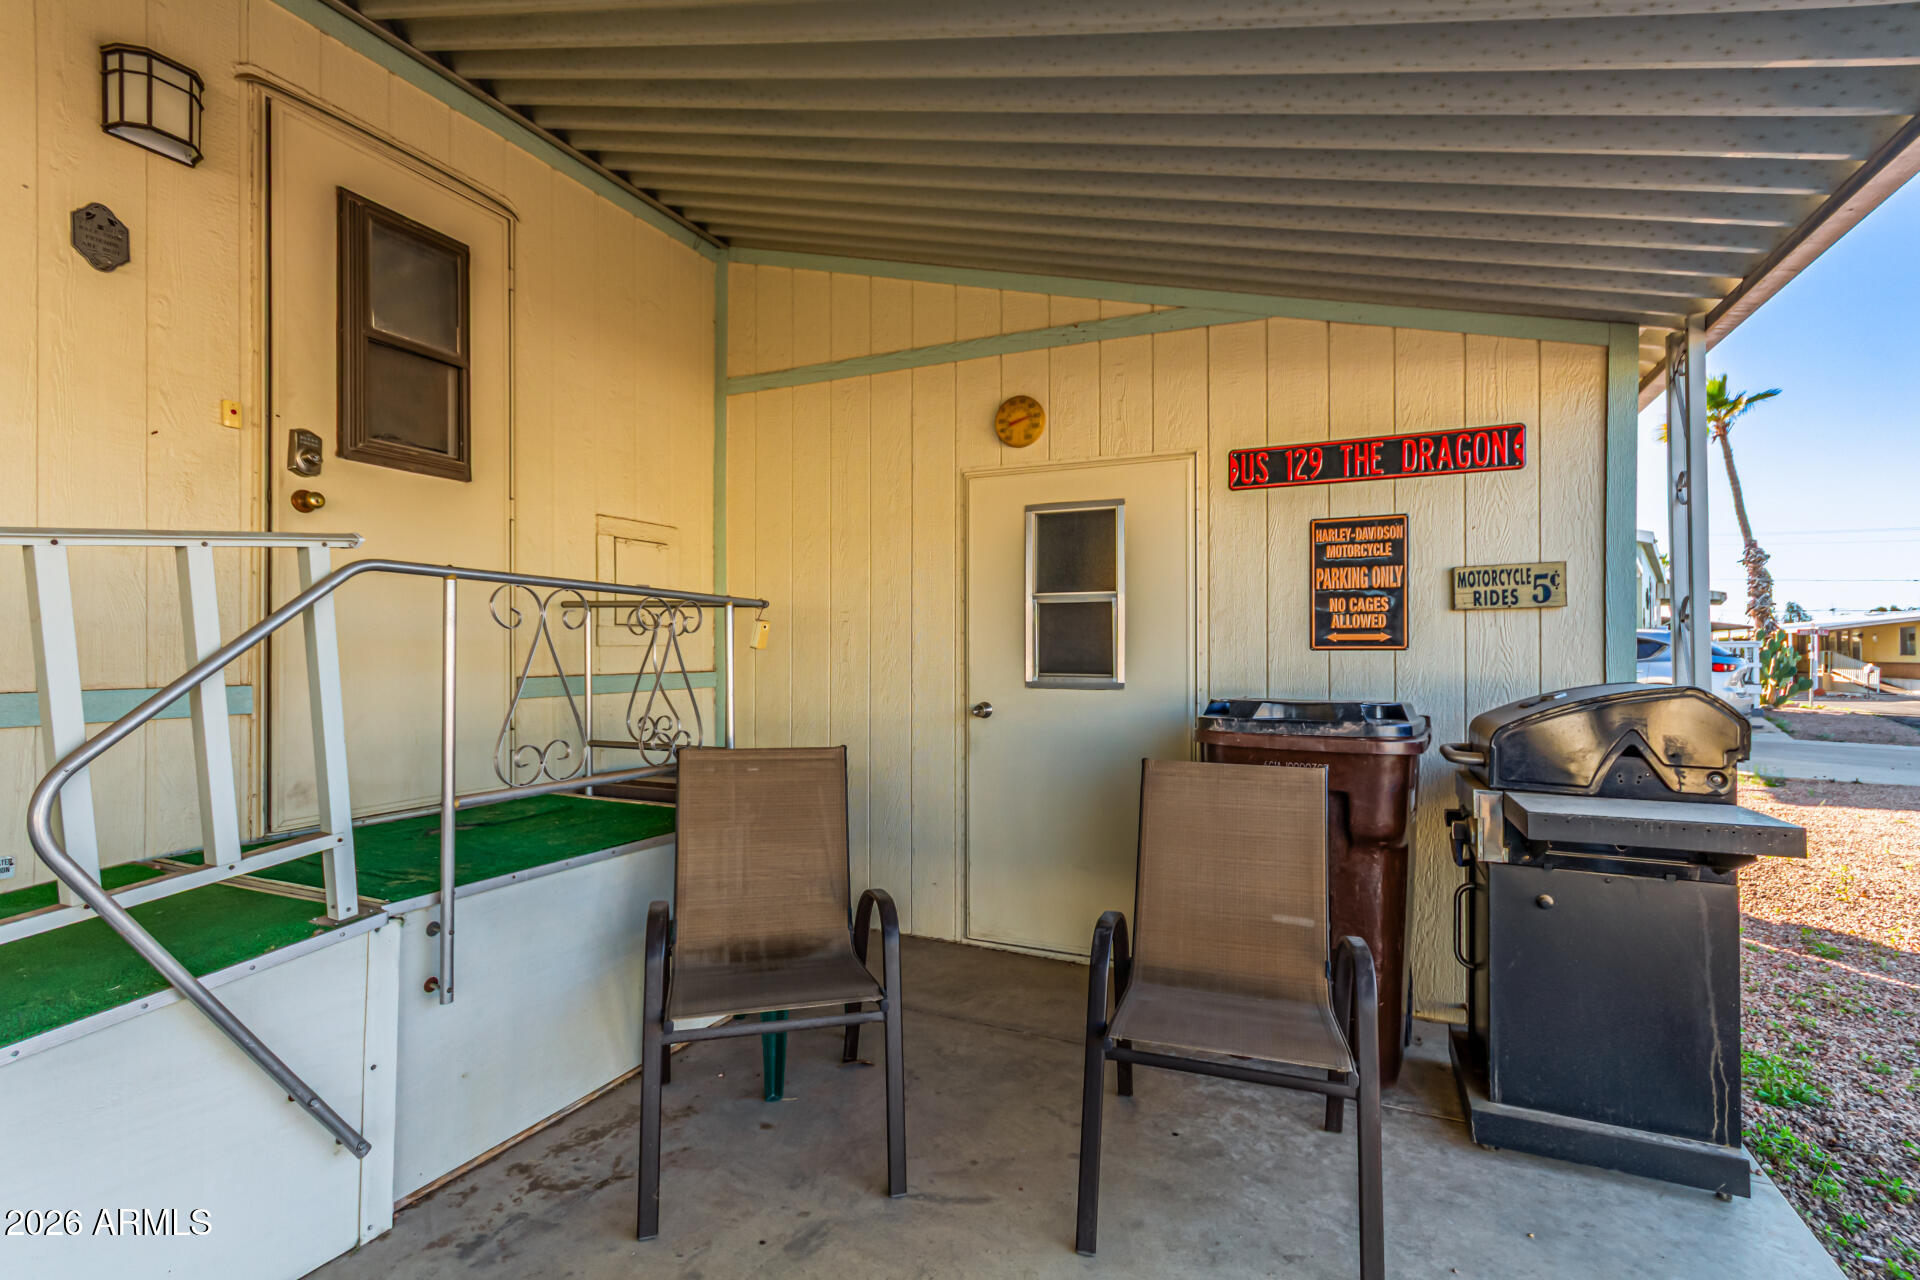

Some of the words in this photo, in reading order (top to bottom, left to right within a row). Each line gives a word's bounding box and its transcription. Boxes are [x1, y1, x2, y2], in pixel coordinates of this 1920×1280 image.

[1240, 452, 1269, 484] US
[1285, 447, 1323, 481] 129
[1340, 441, 1384, 477] THE
[1401, 430, 1509, 473] DRAGON
[1315, 525, 1403, 543] HARLEY-DAVIDSON
[1326, 542, 1393, 559] MOTORCYCLE
[1315, 566, 1369, 590] PARKING
[1371, 565, 1404, 589] ONLY
[1457, 567, 1532, 588] MOTORCYCLE
[1329, 597, 1346, 613] NO
[1349, 596, 1390, 613] CAGES
[1473, 588, 1519, 607] RIDES
[1330, 613, 1388, 629] ALLOWED
